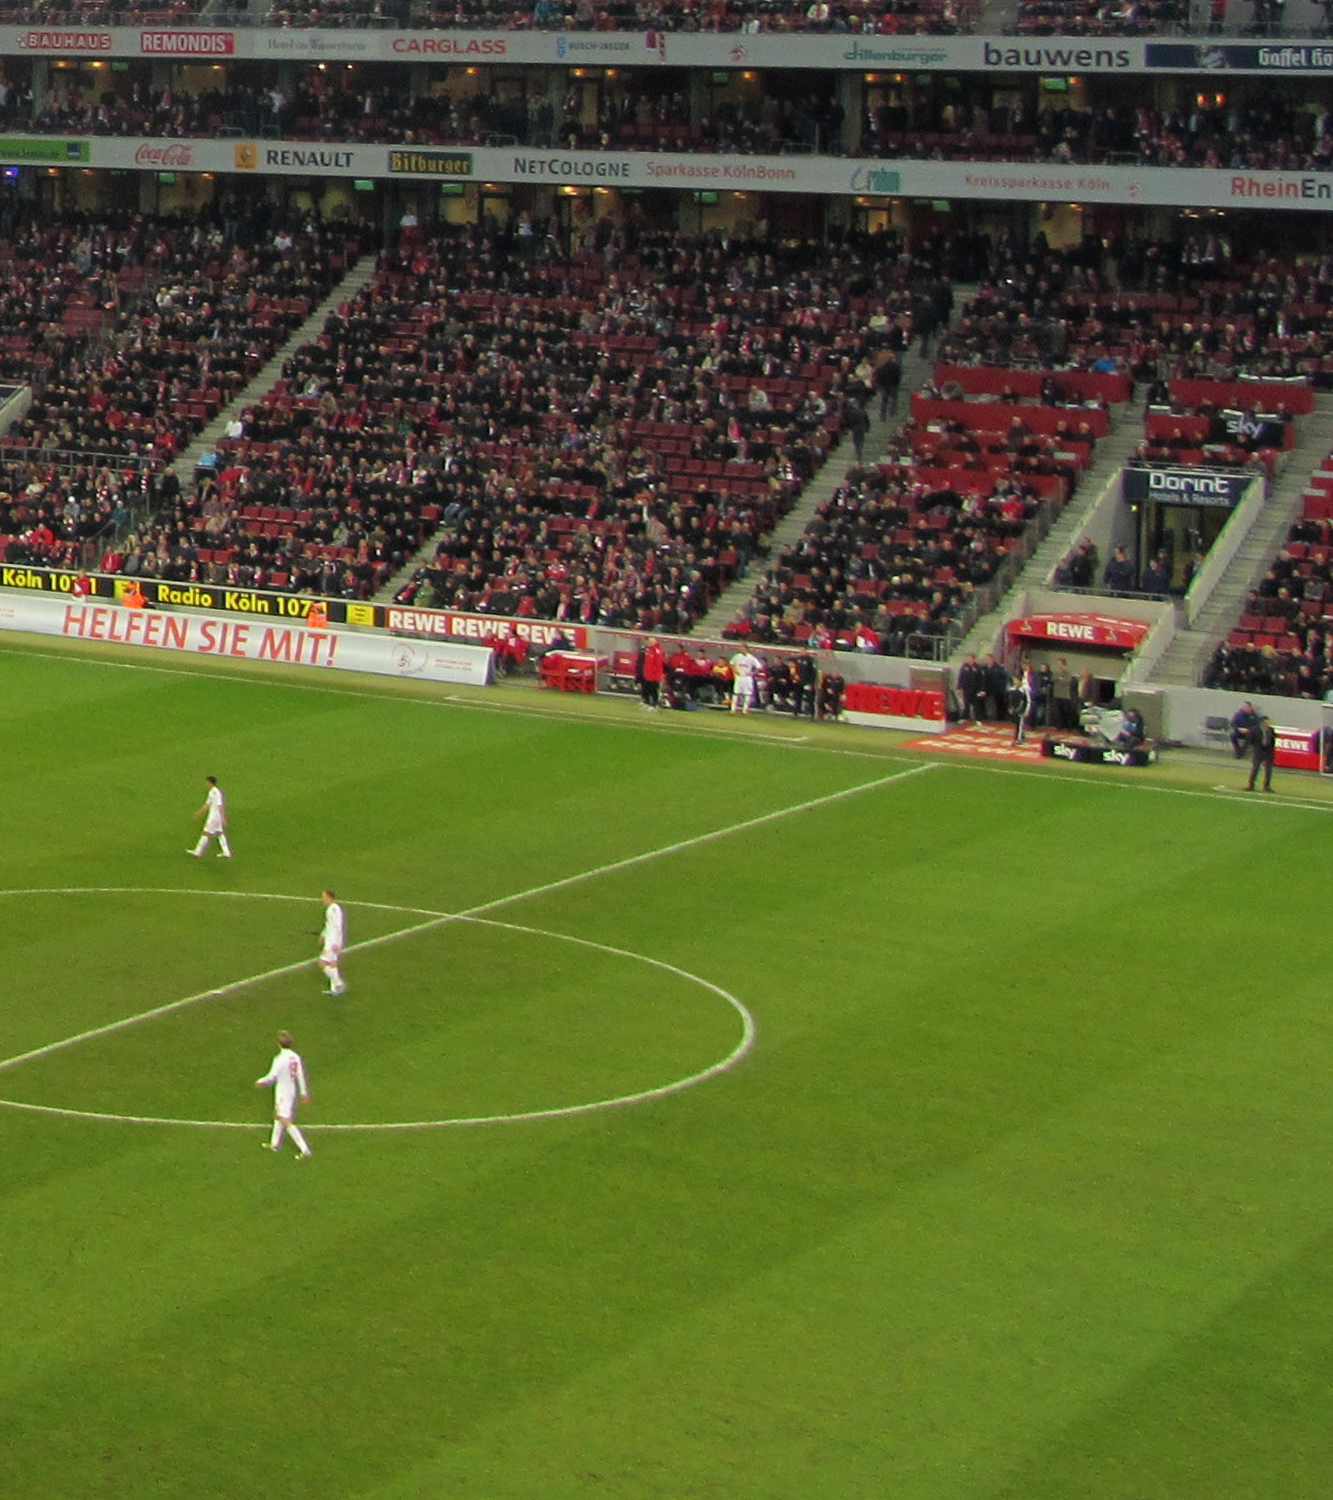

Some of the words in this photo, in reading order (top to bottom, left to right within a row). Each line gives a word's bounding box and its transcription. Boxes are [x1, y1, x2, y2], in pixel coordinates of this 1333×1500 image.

[28, 33, 111, 49] BAUHAUS
[141, 33, 226, 53] REMONDIS
[392, 38, 507, 54] CARGLASS
[983, 42, 1131, 68] bauwens
[265, 149, 355, 169] RENAULT
[391, 153, 470, 175] Bitburger
[645, 161, 720, 180] Sparkasse
[723, 164, 795, 181] KölnBonn
[1077, 177, 1111, 191] Köln
[1149, 473, 1231, 493] Dorint
[2, 568, 43, 591] Köln
[157, 584, 213, 608] Radio
[225, 592, 270, 614] Köln
[62, 604, 190, 651] HELFEN
[197, 619, 251, 657] SIE
[258, 628, 338, 667] MIT!
[388, 610, 447, 634] REWE
[450, 615, 511, 641] REWE
[1046, 621, 1094, 640] REWE
[1053, 742, 1077, 761] sky
[1102, 748, 1130, 766] sky
